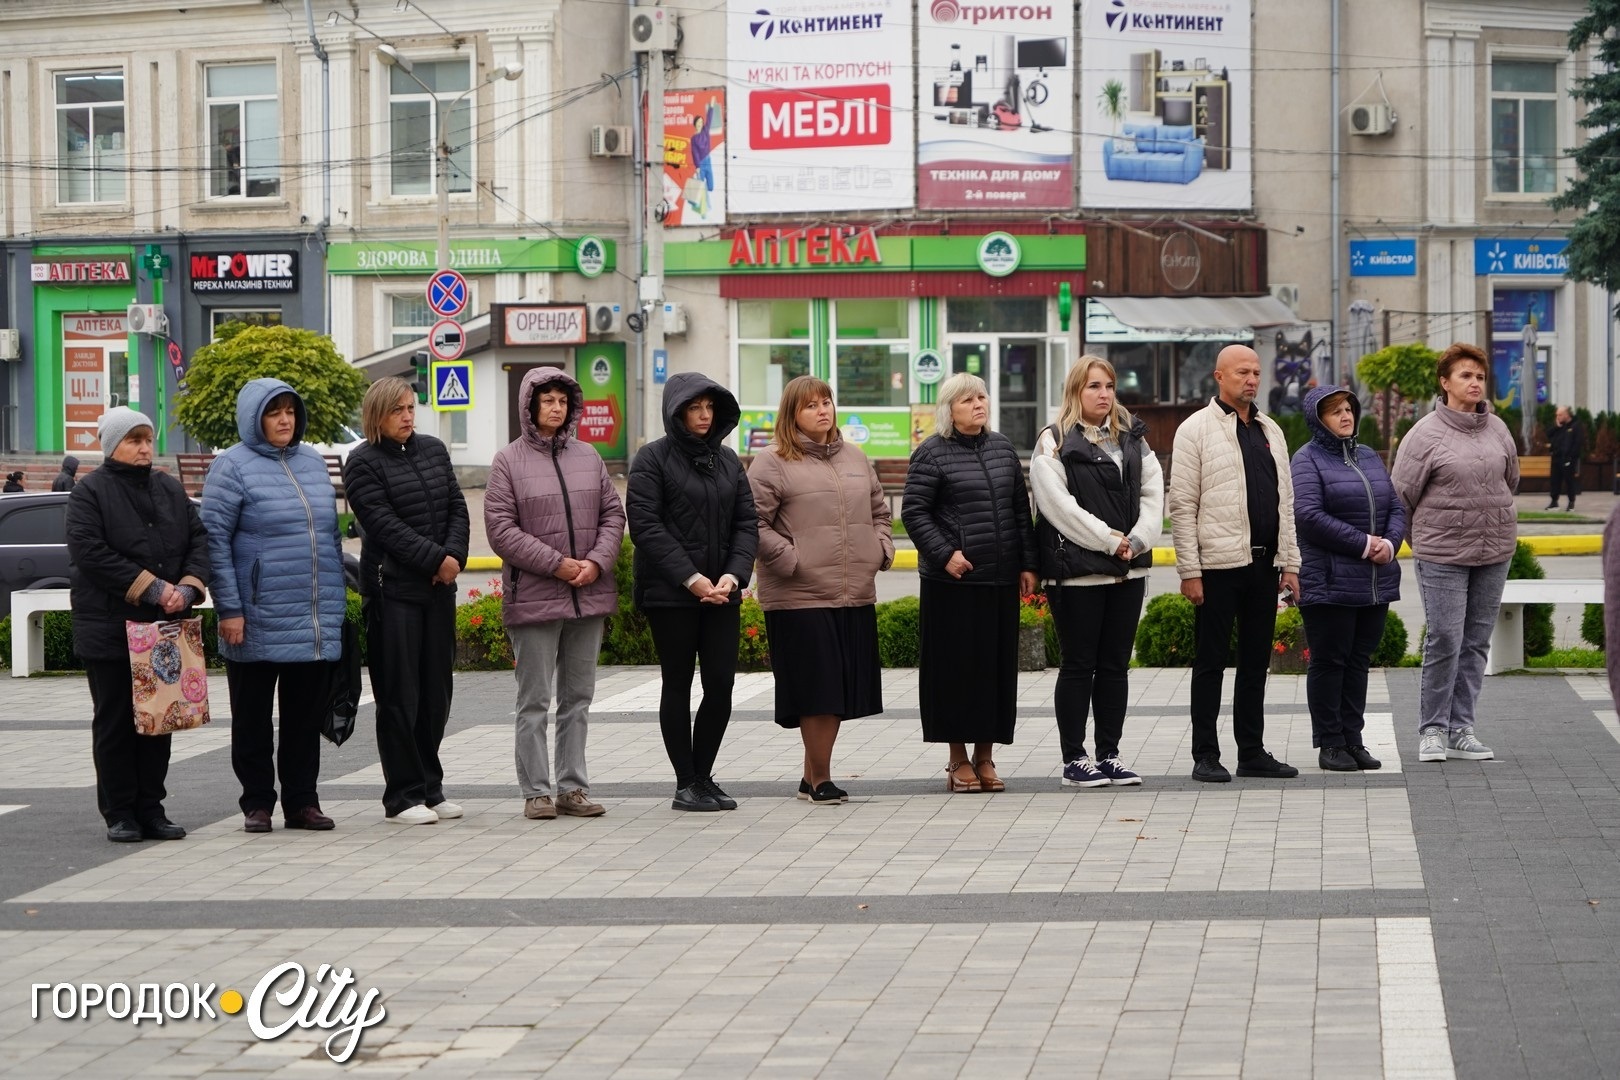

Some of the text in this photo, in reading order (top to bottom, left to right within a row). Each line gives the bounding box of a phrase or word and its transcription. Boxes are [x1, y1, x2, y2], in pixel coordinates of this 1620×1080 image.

[779, 13, 883, 35] КОНТИНЕНТ
[1132, 12, 1224, 32] КОНТИНЕНТ
[793, 65, 811, 81] ТА
[814, 60, 892, 80] КОРПУСНІ
[762, 97, 878, 139] МЕБЛІ
[929, 169, 1062, 182] ТЕХНІКА ДЛЯ ДОМУ
[985, 191, 1027, 201] поверх
[728, 226, 882, 266] АПТЕКА
[357, 250, 429, 269] ЗДОРОВА
[1369, 251, 1414, 265] КИЇВСТАР
[1513, 244, 1570, 270] КИЇВСТА
[49, 261, 130, 281] АПТЕКА
[193, 279, 293, 291] МЕРЕЖА МАГАЗИНІВ ТЕХНІКИ
[75, 319, 122, 331] АПТЕКА
[516, 311, 579, 333] ОРЕНДА
[585, 405, 610, 415] ТВОЯ
[580, 416, 615, 427] АПТЕКА
[589, 426, 606, 437] ТУТ
